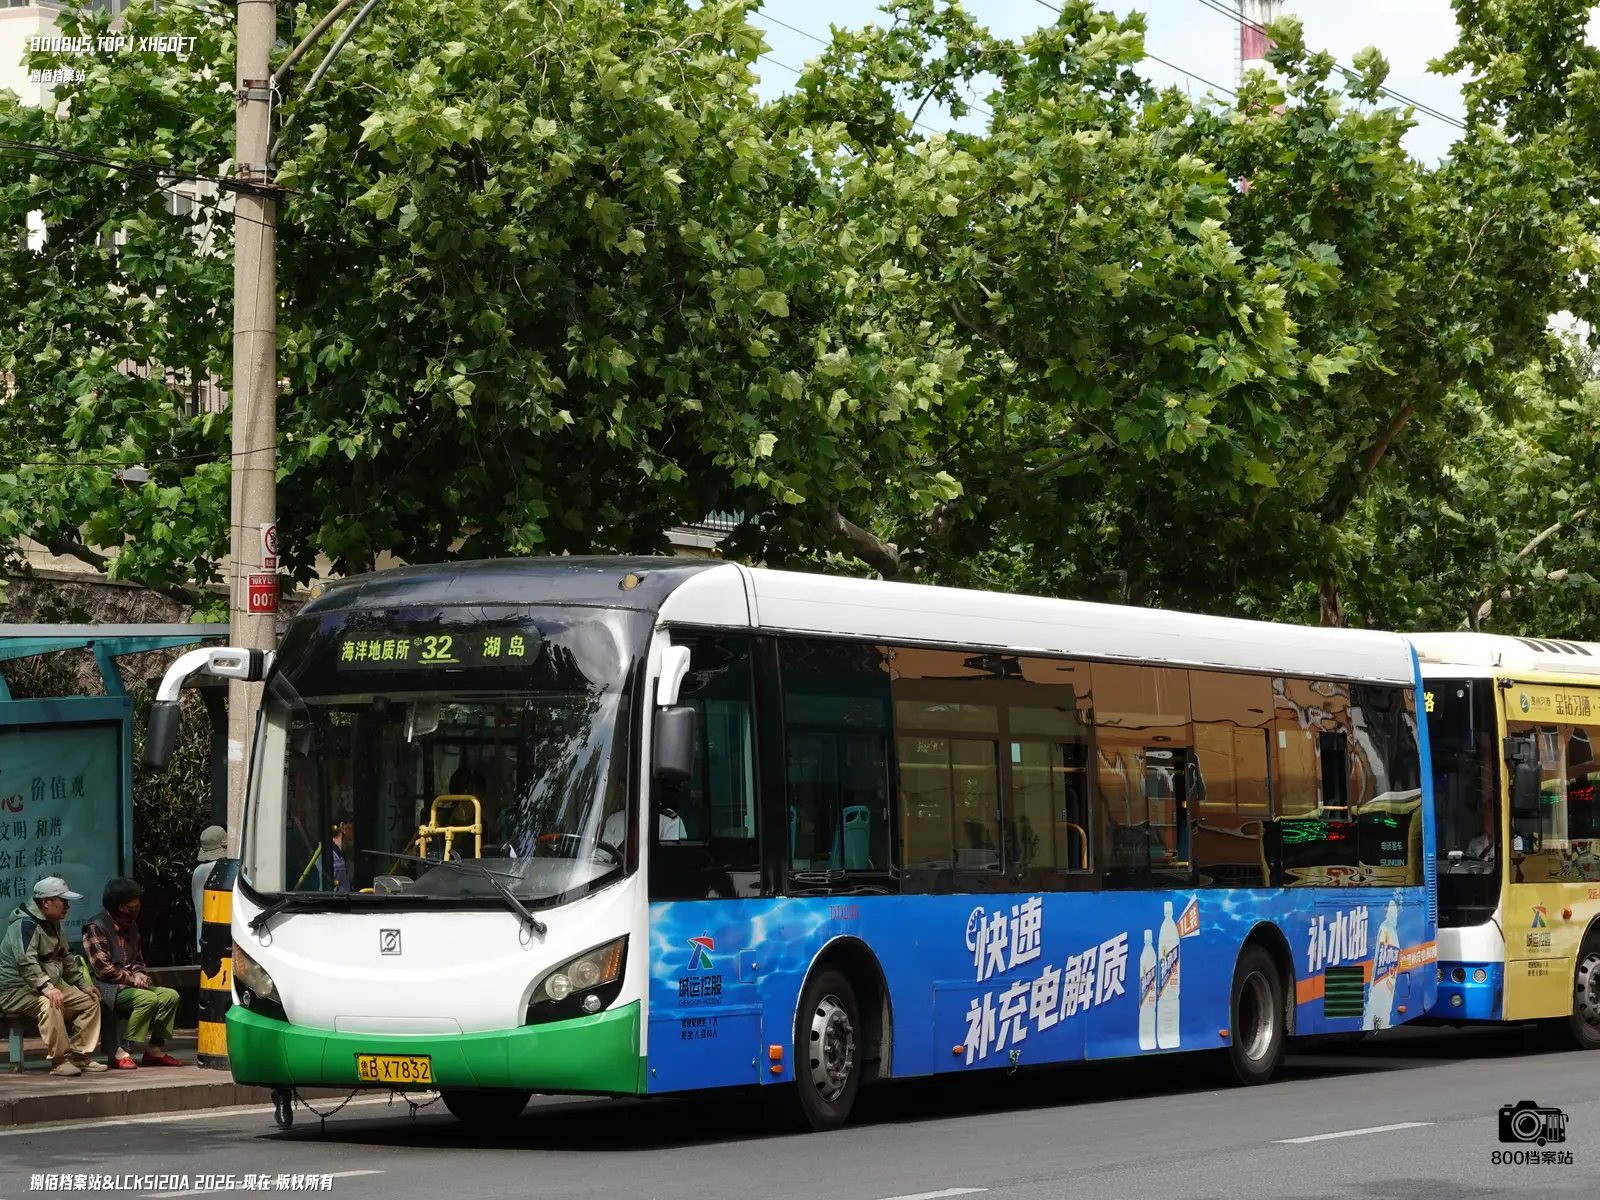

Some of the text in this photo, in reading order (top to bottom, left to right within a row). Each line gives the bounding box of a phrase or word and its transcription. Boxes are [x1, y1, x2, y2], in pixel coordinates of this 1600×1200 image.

[341, 635, 525, 662] 海洋地质所 32 湖岛
[30, 775, 86, 801] 价值观
[36, 817, 63, 839] 和谐
[34, 845, 63, 867] 法治
[974, 896, 1042, 982] 快速
[1307, 904, 1369, 974] 补水啦
[678, 974, 722, 998] 城运控股
[963, 931, 1129, 1066] 补充电解质
